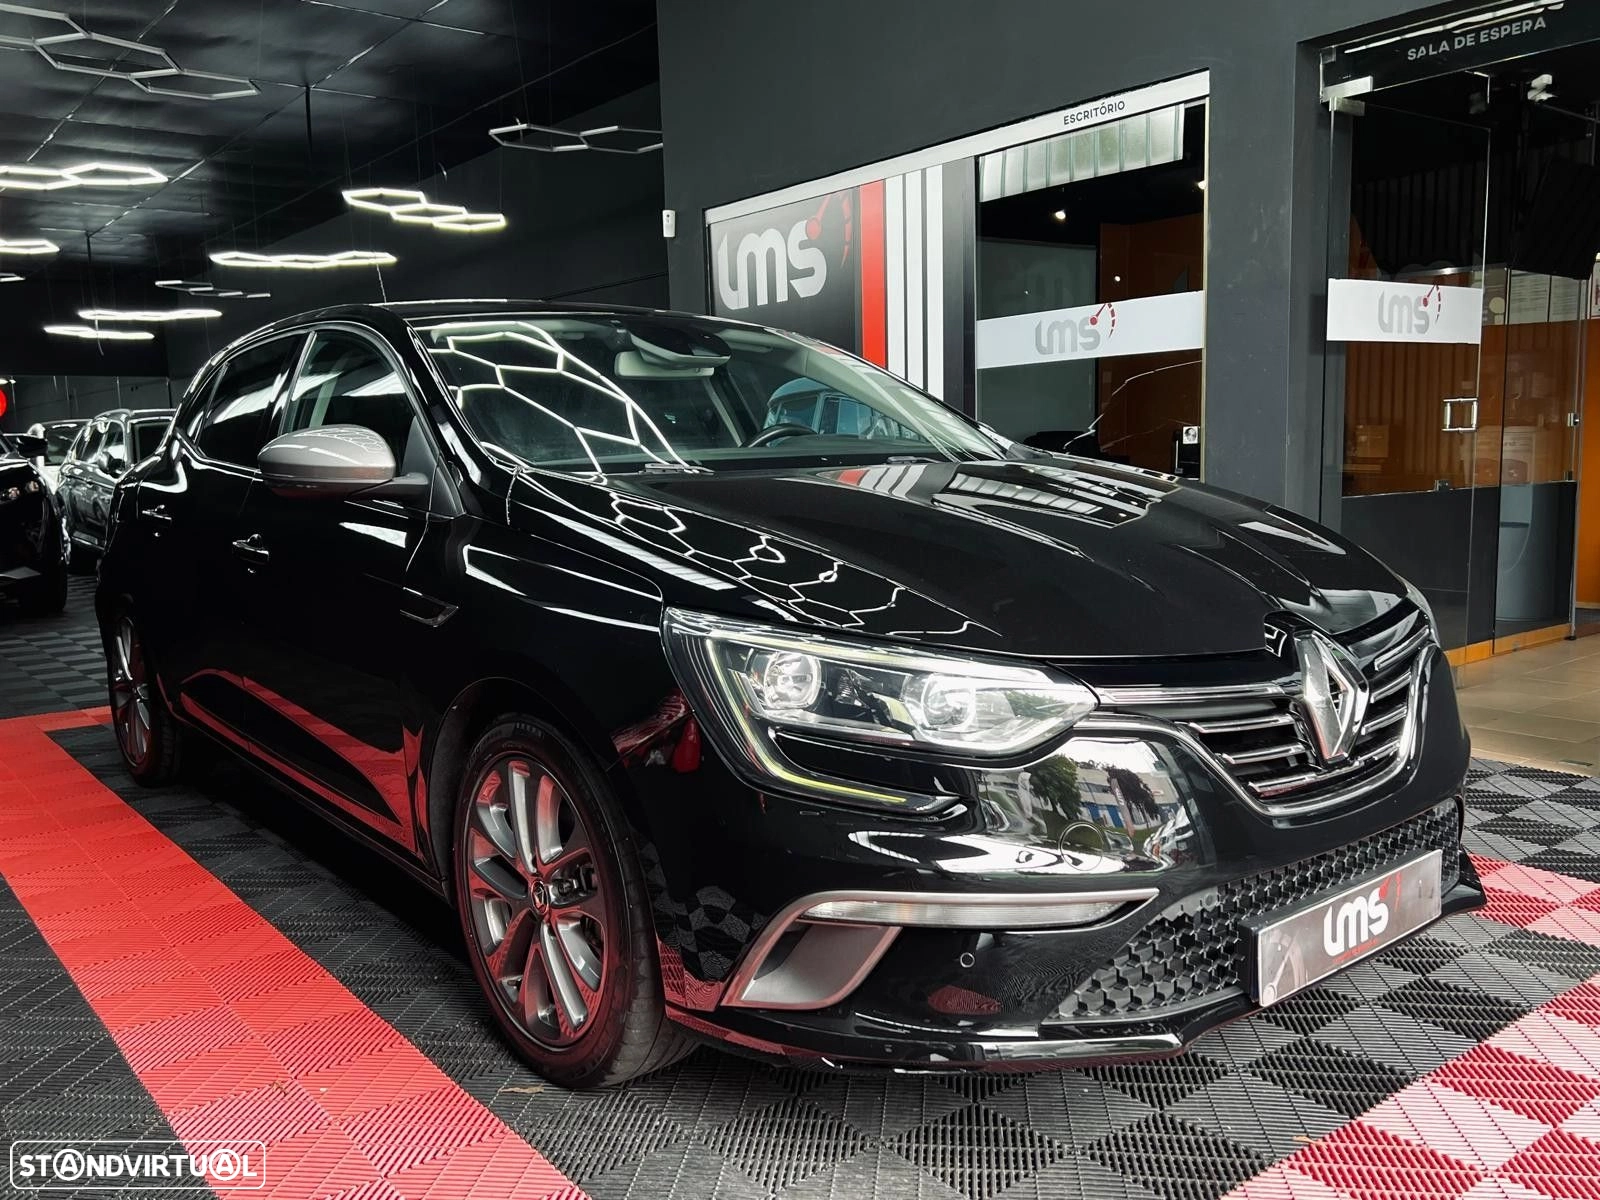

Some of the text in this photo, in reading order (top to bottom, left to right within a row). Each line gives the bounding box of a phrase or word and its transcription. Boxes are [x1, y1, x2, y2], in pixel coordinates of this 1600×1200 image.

[1407, 16, 1547, 60] SALA DE ESPERA
[1063, 101, 1126, 125] ESCRITÓRIO
